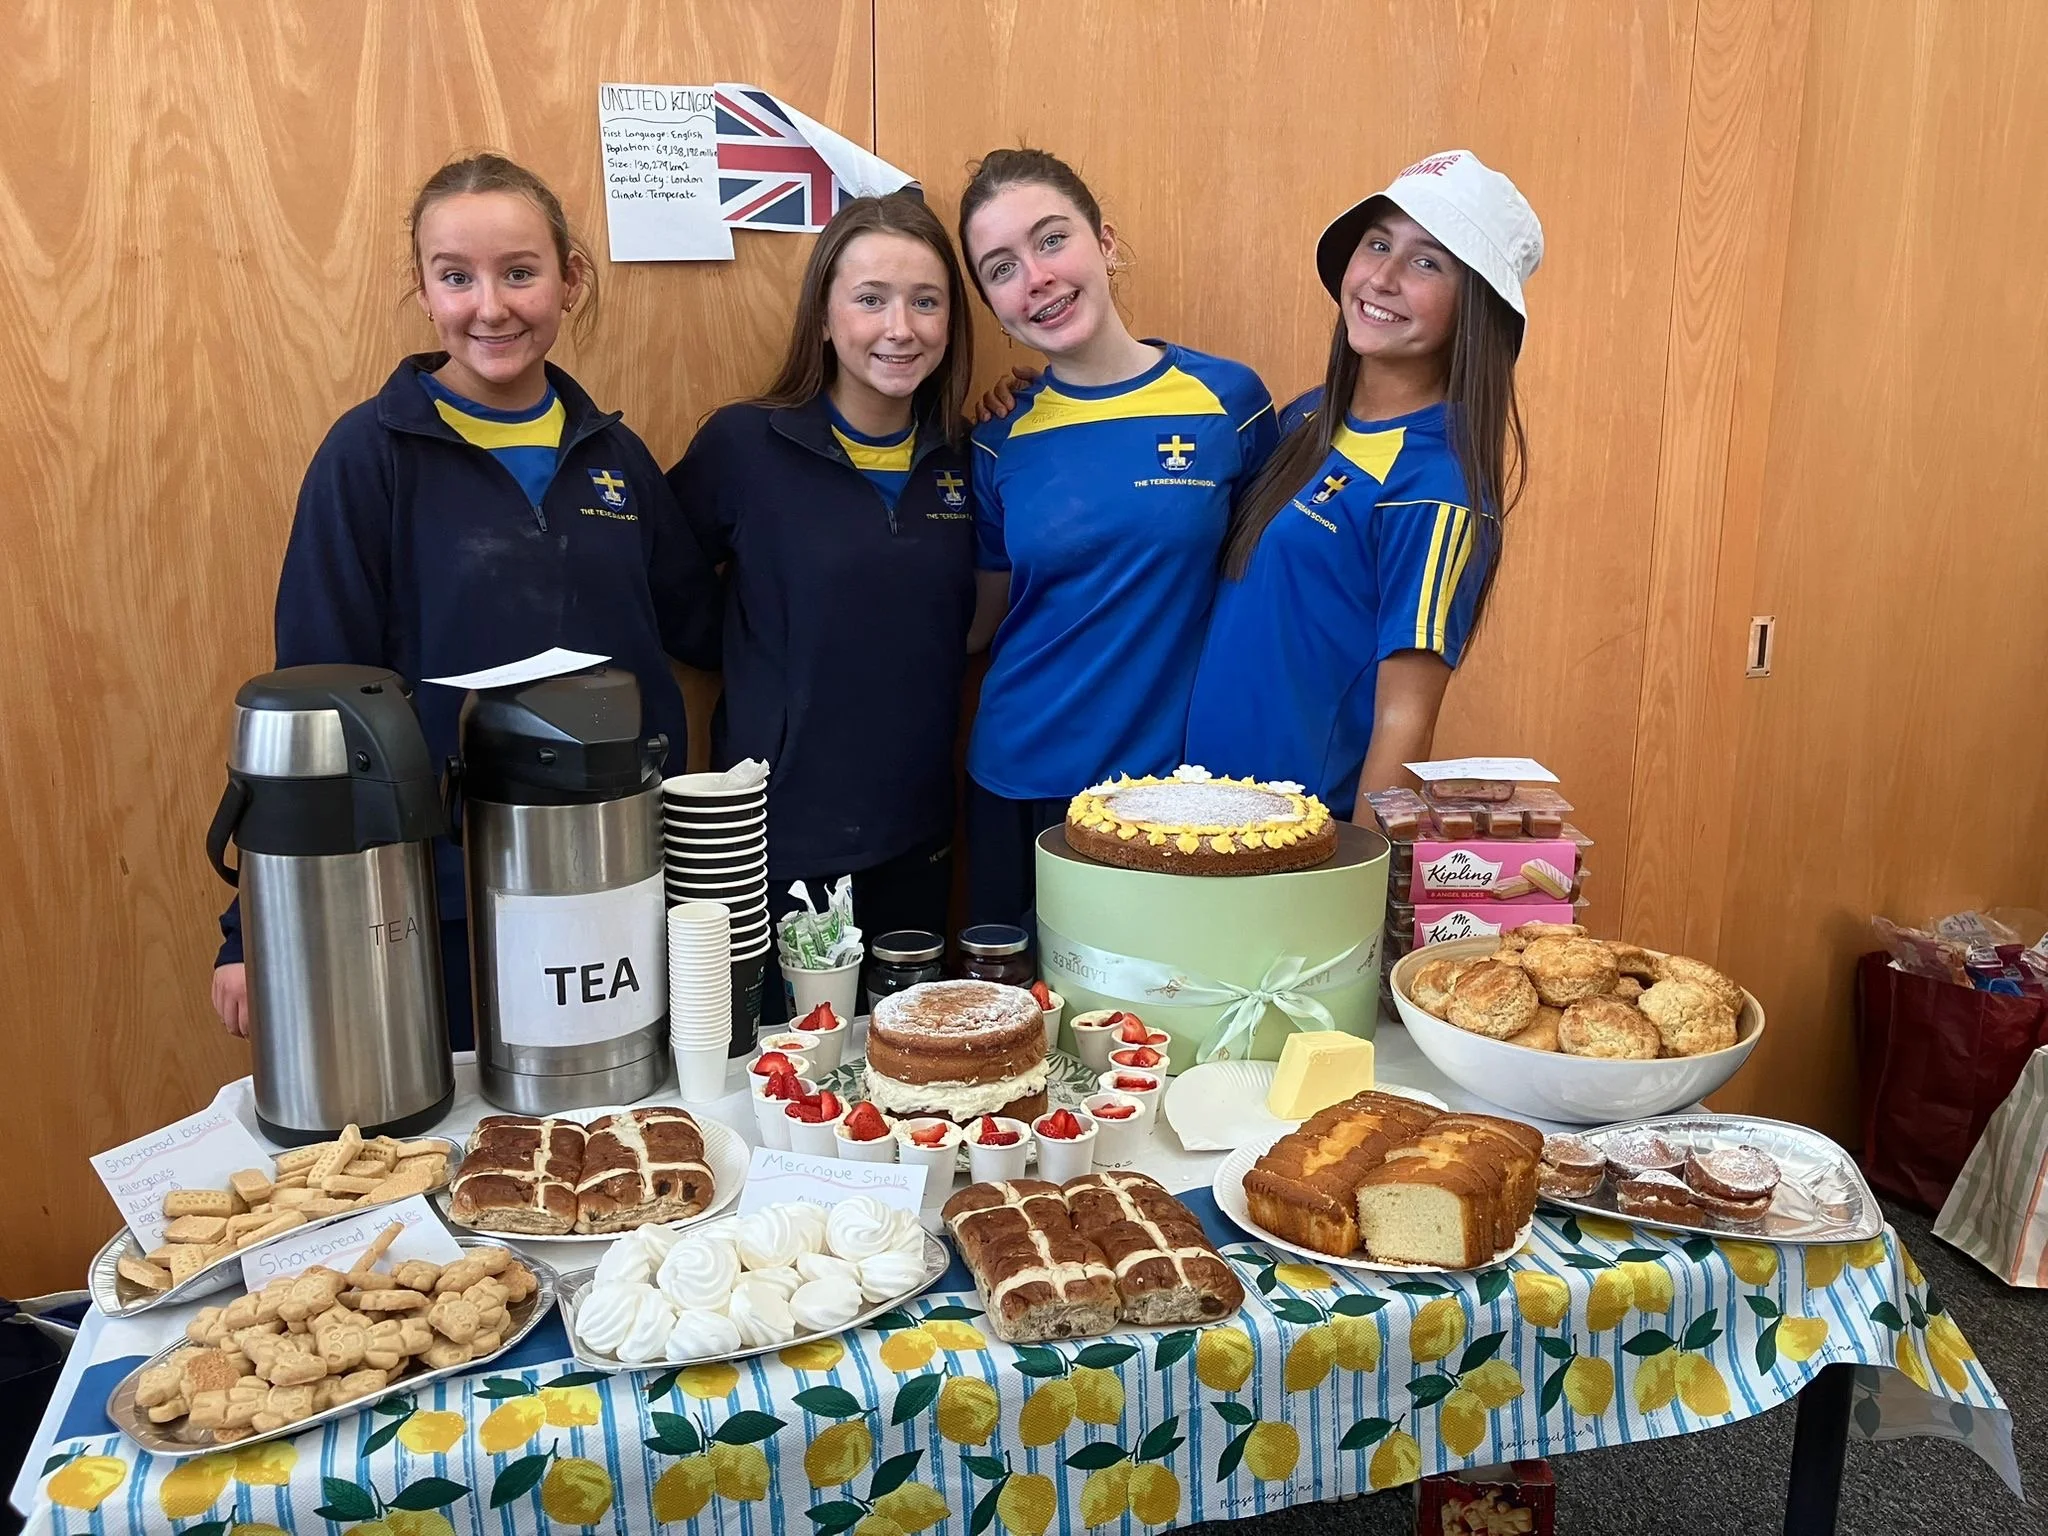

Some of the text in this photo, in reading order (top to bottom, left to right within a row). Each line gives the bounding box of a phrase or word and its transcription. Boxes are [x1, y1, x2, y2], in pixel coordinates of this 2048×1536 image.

[601, 86, 667, 111] UNITED
[602, 127, 621, 138] First
[670, 130, 703, 139] English
[608, 159, 632, 169] Size:
[609, 173, 641, 184] Capital
[670, 175, 703, 184] London
[648, 189, 697, 202] Temperate
[1133, 480, 1149, 488] THE
[1187, 479, 1216, 487] SCHOOL
[580, 508, 595, 516] THE
[1310, 511, 1338, 534] SCHOOL
[1451, 852, 1470, 864] Mr
[1427, 865, 1494, 886] Kipling
[1451, 913, 1470, 925] Mr
[369, 916, 420, 947] TEA
[544, 957, 640, 1006] TEA
[762, 1152, 909, 1187] Meringue Shells
[259, 1227, 365, 1275] Shortbread
